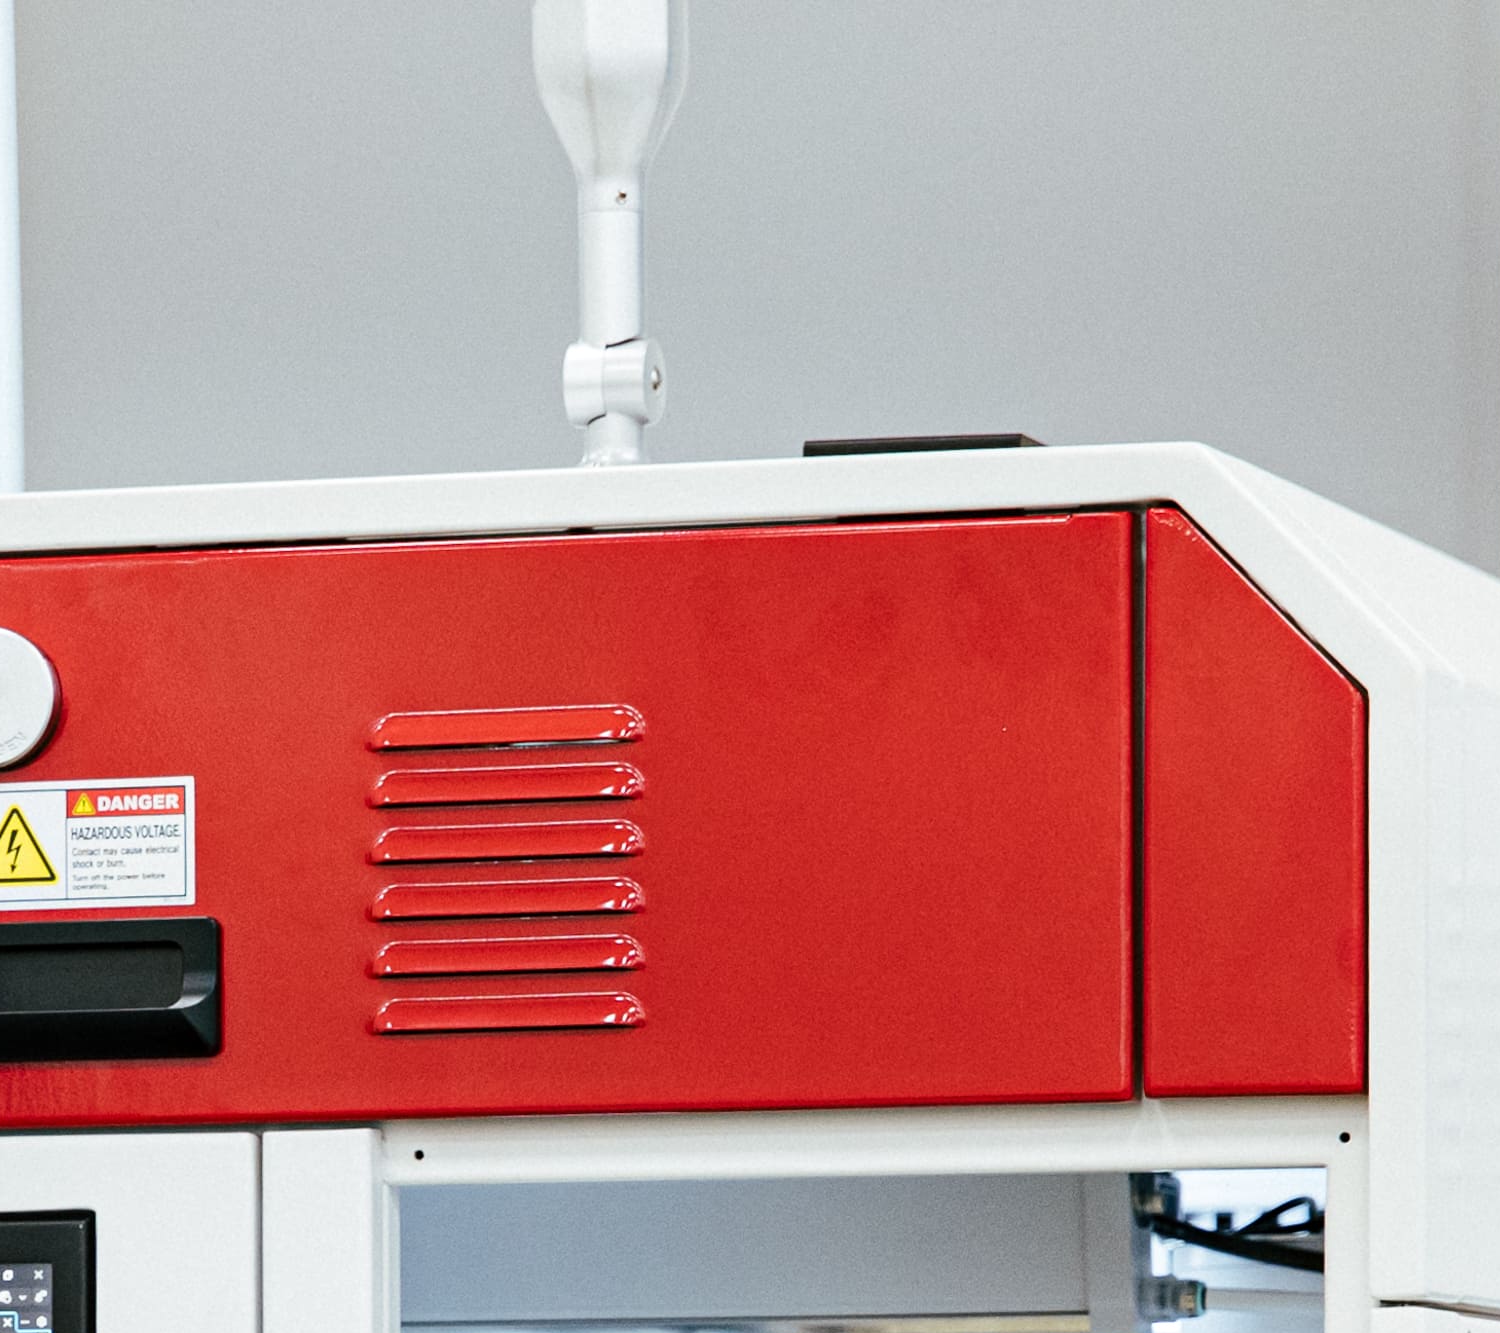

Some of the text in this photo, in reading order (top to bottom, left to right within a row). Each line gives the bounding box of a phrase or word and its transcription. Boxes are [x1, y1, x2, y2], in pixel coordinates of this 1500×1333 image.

[97, 793, 180, 812] DANGER
[71, 826, 132, 840] HAZARDOUS
[72, 845, 179, 856] Contact may cause electrical
[72, 860, 93, 869] shock
